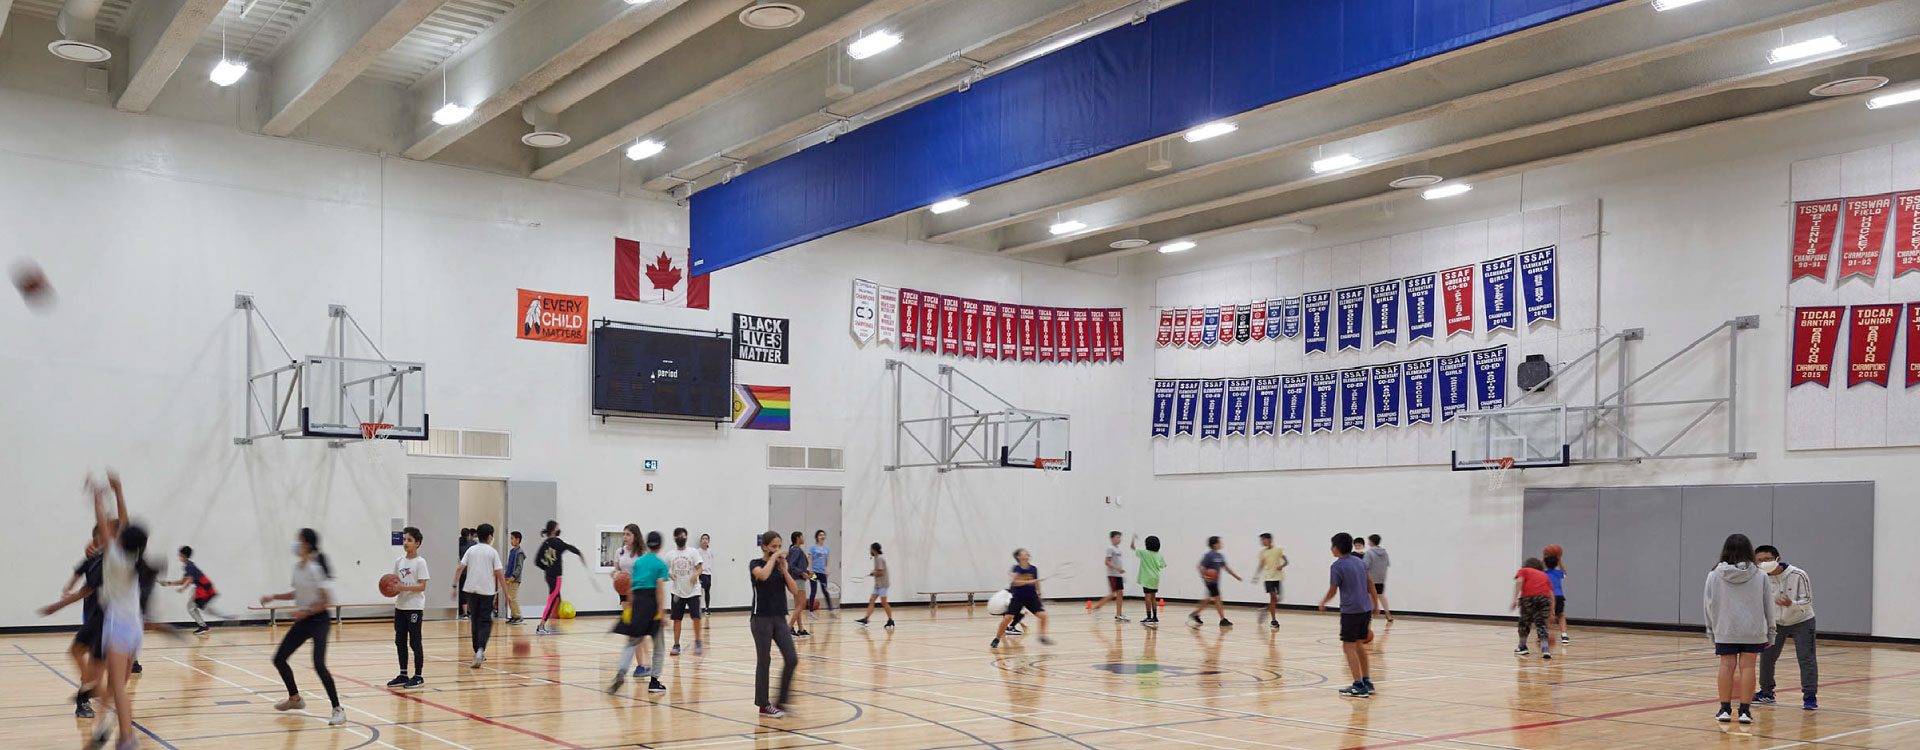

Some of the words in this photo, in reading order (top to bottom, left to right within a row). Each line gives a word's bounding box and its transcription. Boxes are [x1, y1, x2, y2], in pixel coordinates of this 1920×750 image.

[1800, 204, 1838, 214] TSSWAA
[1848, 199, 1890, 210] TSSWAA
[1858, 216, 1872, 251] HOCKEY
[1524, 251, 1550, 263] SSAF
[1794, 254, 1827, 262] CHAMPIONS
[1486, 260, 1511, 271] SSAF
[1523, 258, 1552, 269] ELEMENTARY
[1445, 270, 1469, 279] SSAF
[1485, 268, 1512, 277] ELEMENTARY
[1528, 266, 1548, 274] GIRLS
[1409, 277, 1432, 287] SSAF
[1490, 274, 1508, 283] GIRLS
[1374, 284, 1397, 293] SSAF
[1341, 291, 1362, 299] SSAF
[543, 298, 582, 312] EVERY
[1528, 303, 1552, 312] CHAMPIONS
[1802, 311, 1836, 319] TDCAA
[1858, 309, 1894, 318] TDCAA
[542, 312, 582, 328] CHILD
[740, 316, 782, 333] BLACK
[1411, 322, 1432, 330] CHAMPIONS
[542, 328, 582, 338] MATTERS
[741, 330, 781, 348] LIVES
[740, 346, 781, 362] MATTER
[1477, 350, 1502, 360] SSAF
[1441, 356, 1466, 365] SSAF
[1407, 361, 1430, 370] SSAF
[658, 369, 678, 378] period
[1376, 366, 1398, 375] SSAF
